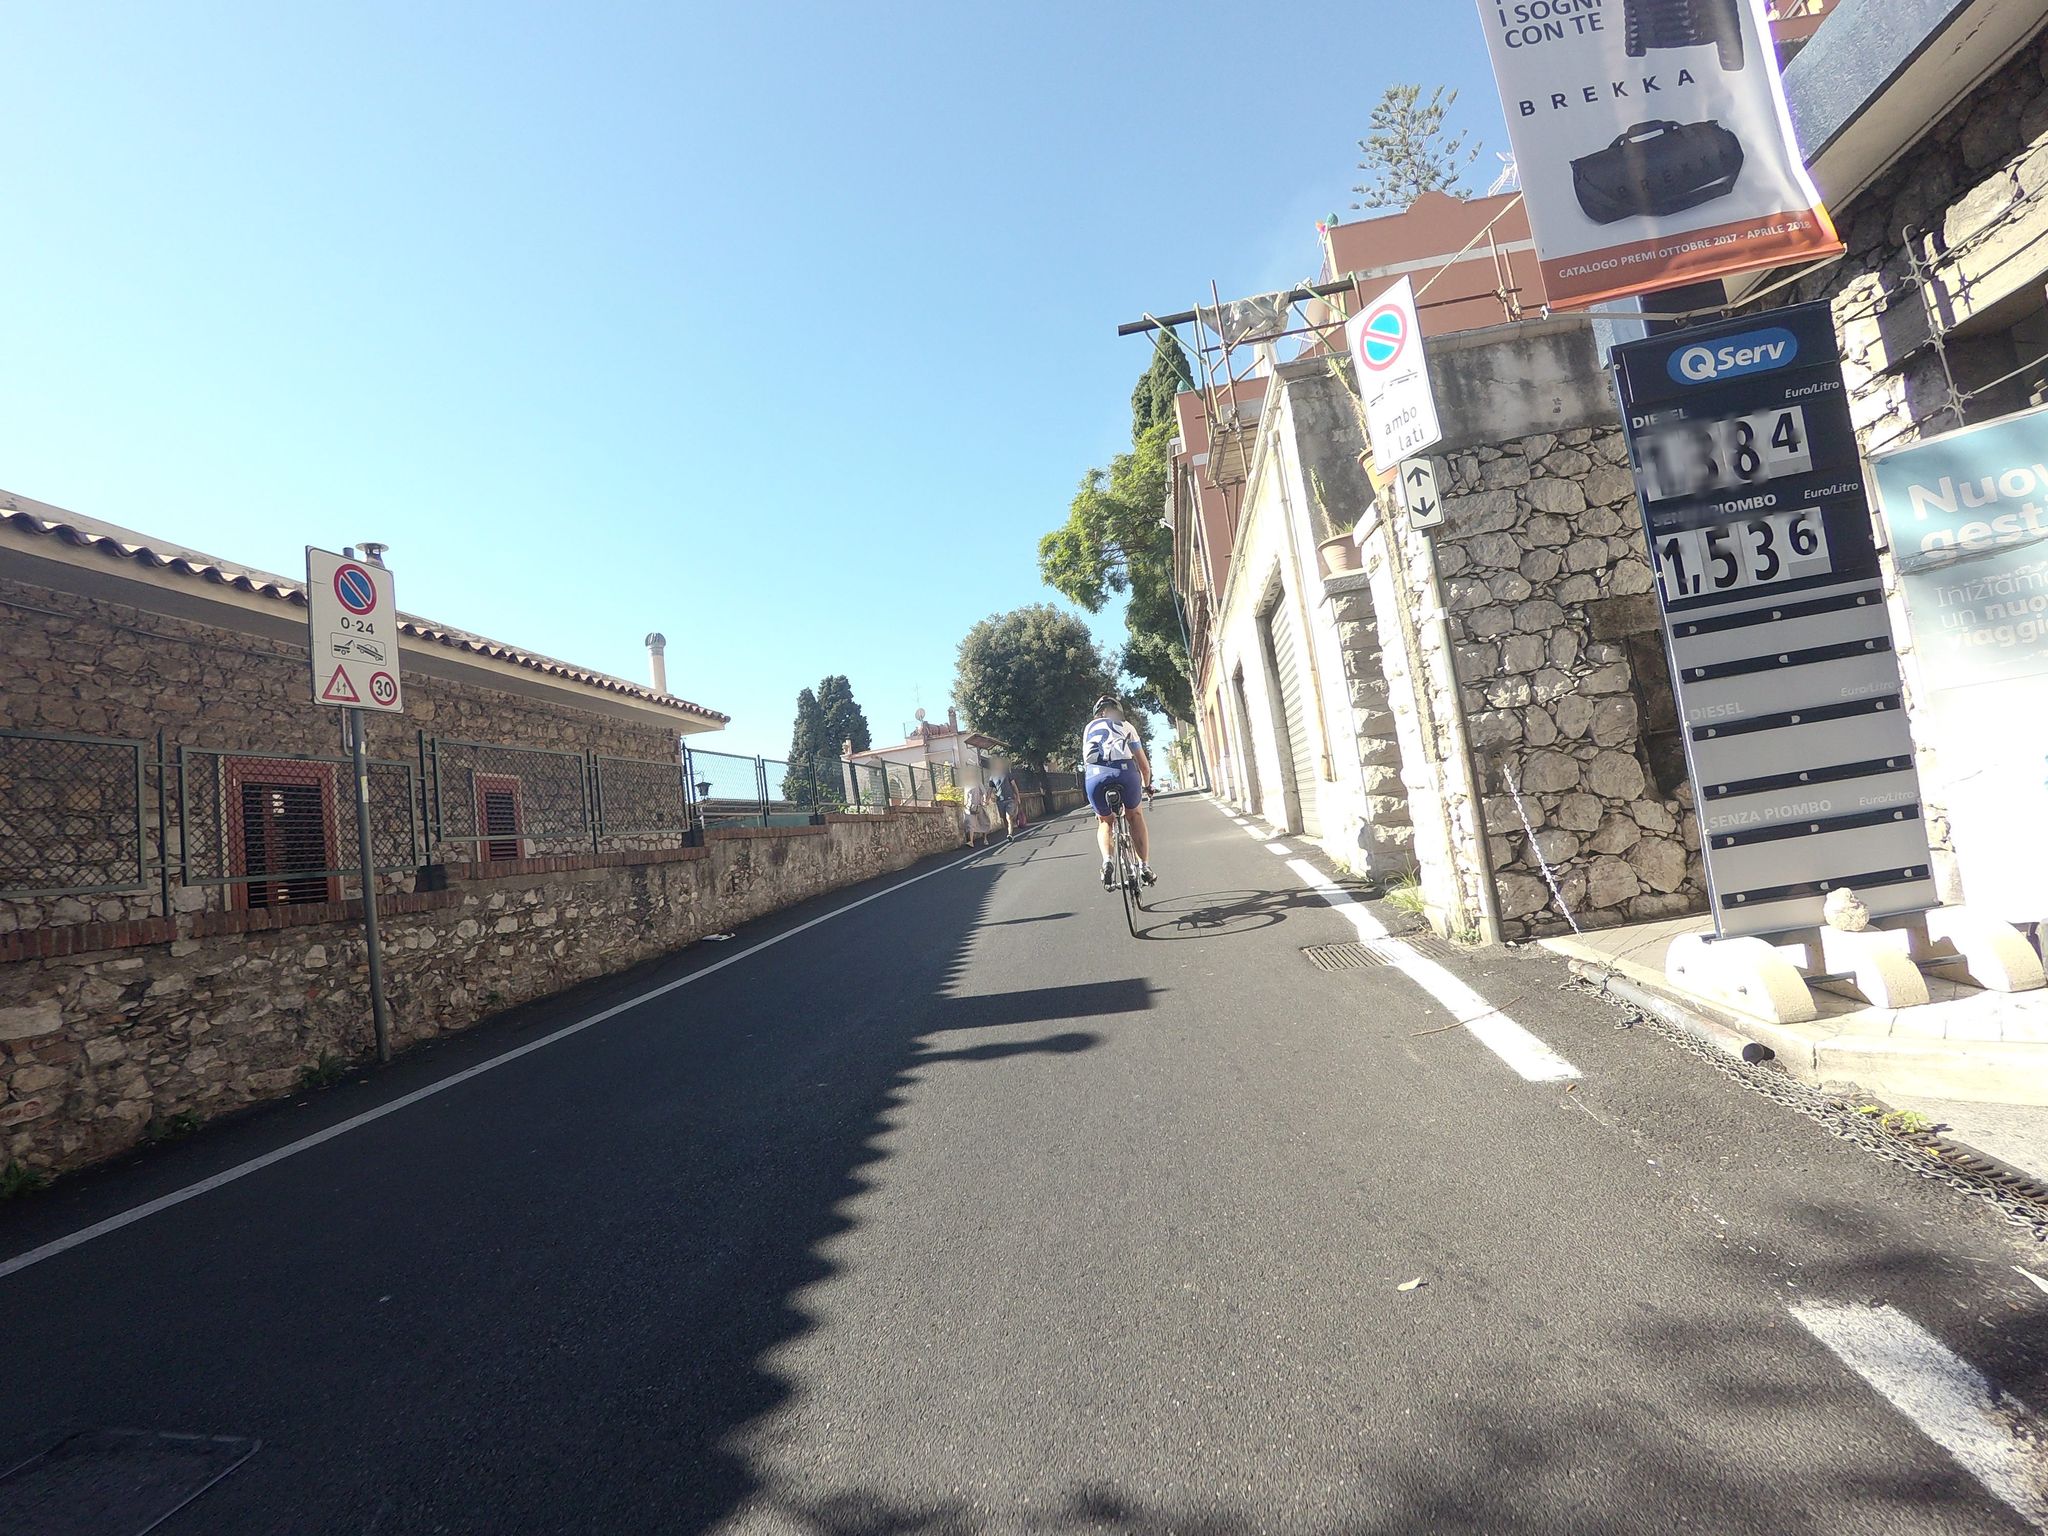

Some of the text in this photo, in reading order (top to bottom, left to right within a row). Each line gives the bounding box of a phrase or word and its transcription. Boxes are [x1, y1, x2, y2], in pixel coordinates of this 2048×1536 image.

[1499, 9, 1507, 27] I
[1505, 12, 1604, 48] CON TE
[1520, 69, 1695, 117] BREKKA
[1559, 258, 1617, 278] CATALOGO
[1621, 251, 1656, 265] PREMI
[1659, 241, 1712, 257] OTTOBRE
[1714, 233, 1737, 246] 2017
[1747, 225, 1784, 239] APRILE
[1787, 221, 1812, 232] 2018
[1680, 340, 1786, 380] QServ
[1785, 380, 1839, 398] Euro/Litro
[1385, 406, 1417, 435] ambo
[1399, 424, 1424, 451] lati
[1804, 481, 1858, 499] Euro/Litro
[1941, 594, 2048, 628] un nuo
[341, 617, 375, 635] 0-24
[375, 680, 392, 697] 30
[1841, 680, 1894, 697] Euro/Litro
[1689, 702, 1744, 720] DIESEL
[1859, 789, 1914, 806] Euro/Litro
[1710, 799, 1831, 829] SENZA PIOMBO
